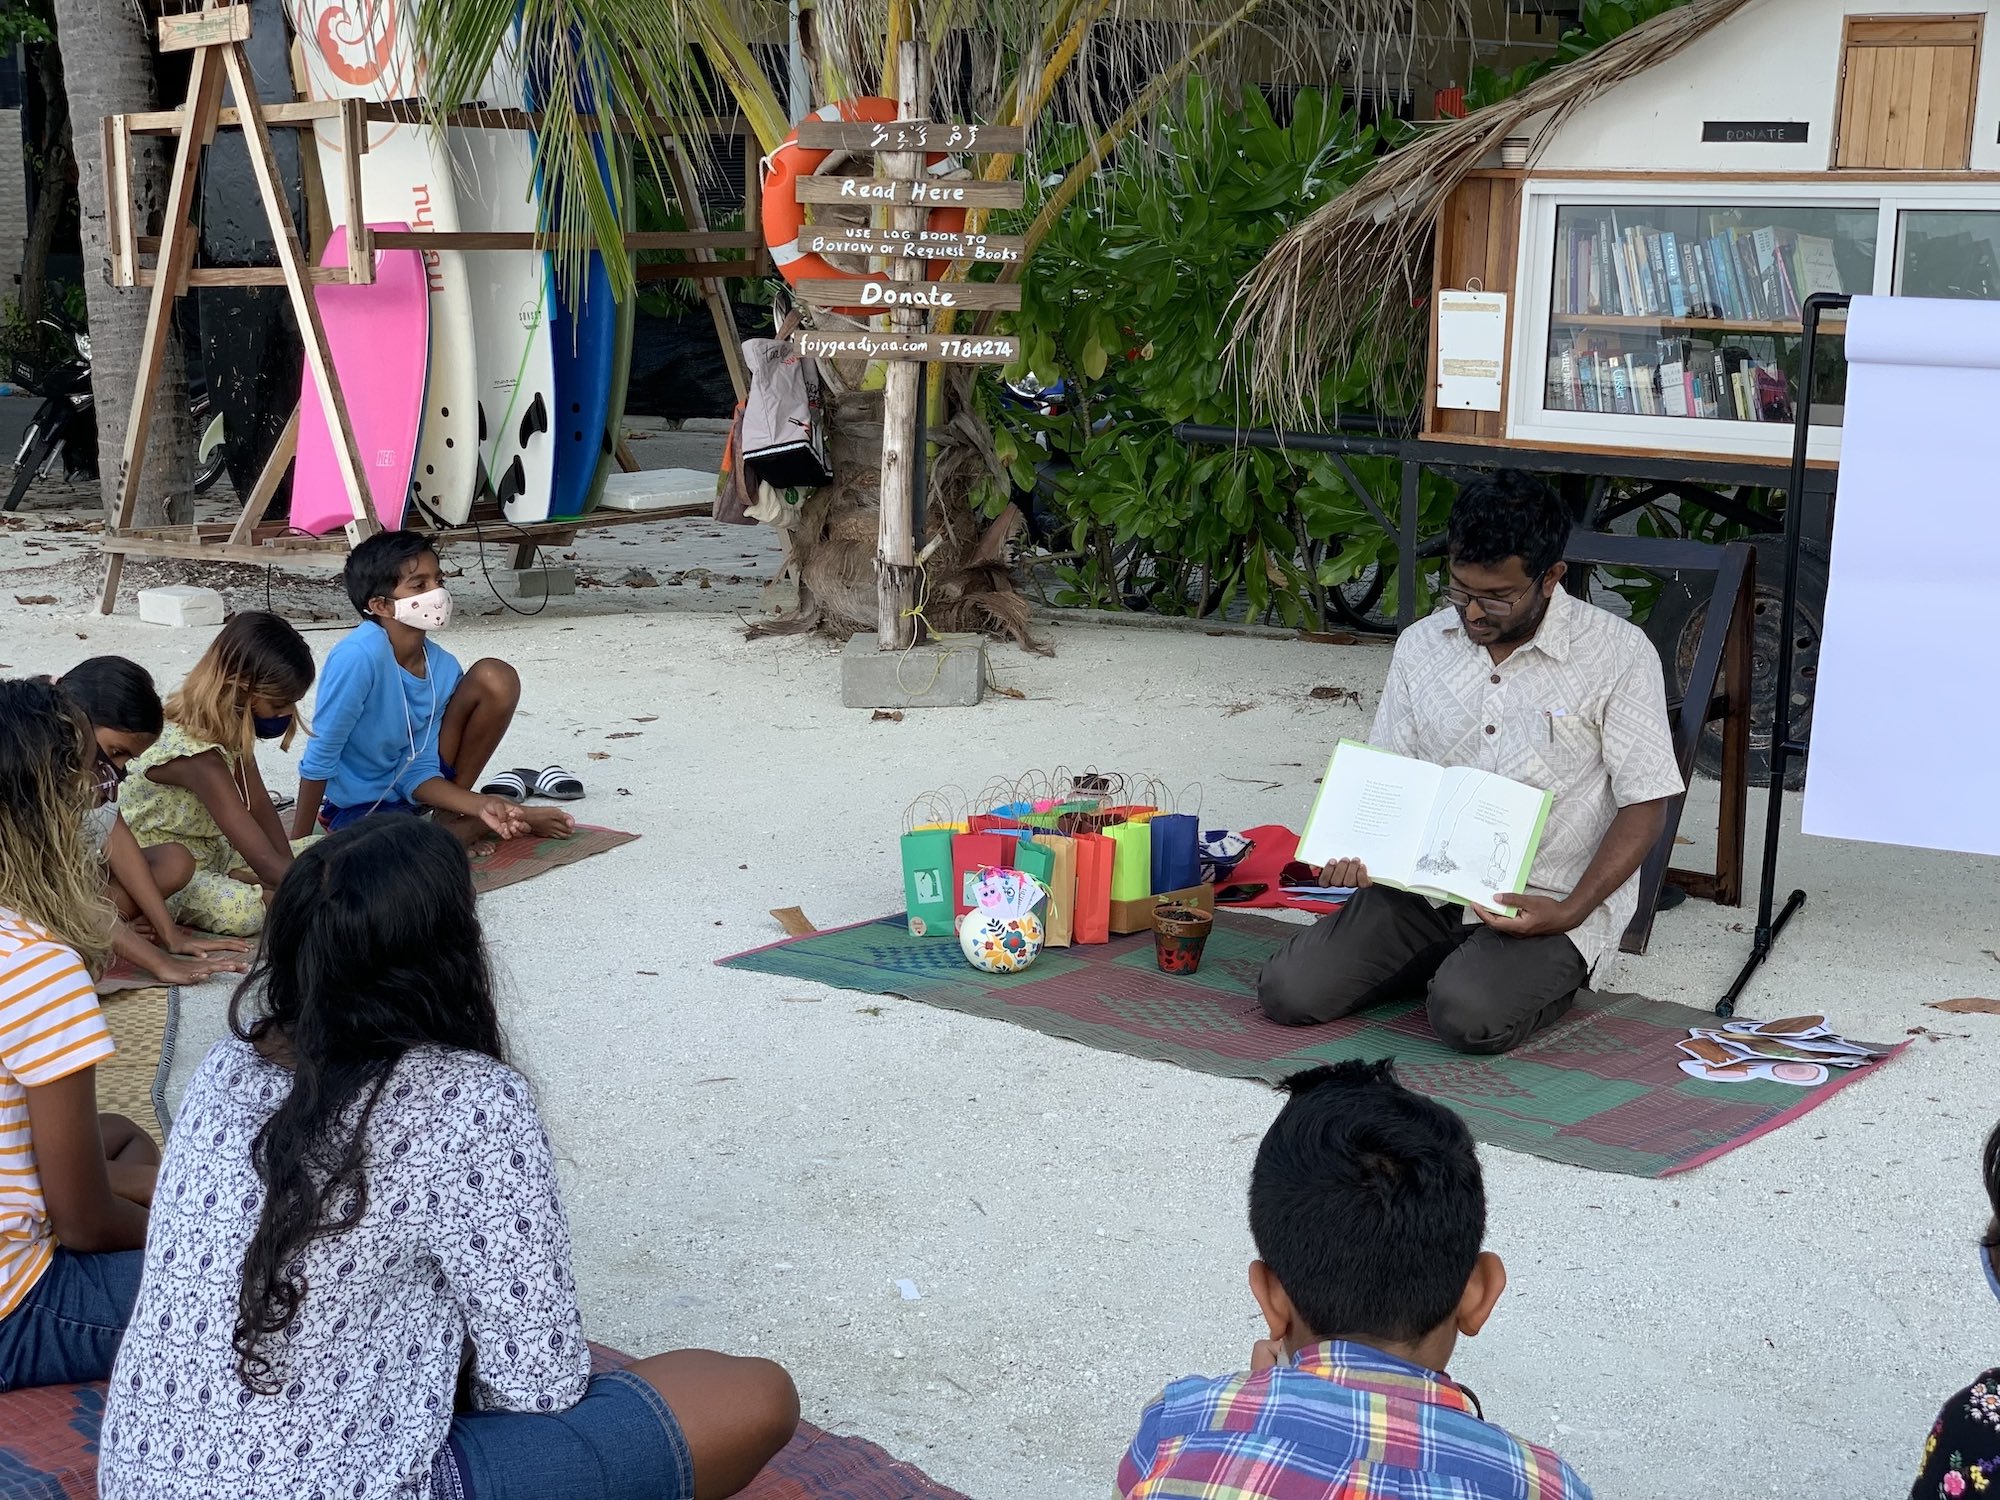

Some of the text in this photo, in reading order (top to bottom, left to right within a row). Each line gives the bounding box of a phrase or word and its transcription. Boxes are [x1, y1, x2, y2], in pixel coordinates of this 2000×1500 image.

[1726, 128, 1785, 141] DONATE
[840, 179, 964, 201] Read Here
[845, 226, 987, 247] USE LOG BOOK TO
[811, 235, 1018, 261] Borrow or Request Books
[860, 283, 957, 306] Donate
[800, 333, 928, 357] foiygaadiyaa.com
[940, 340, 1013, 358] 7784274
